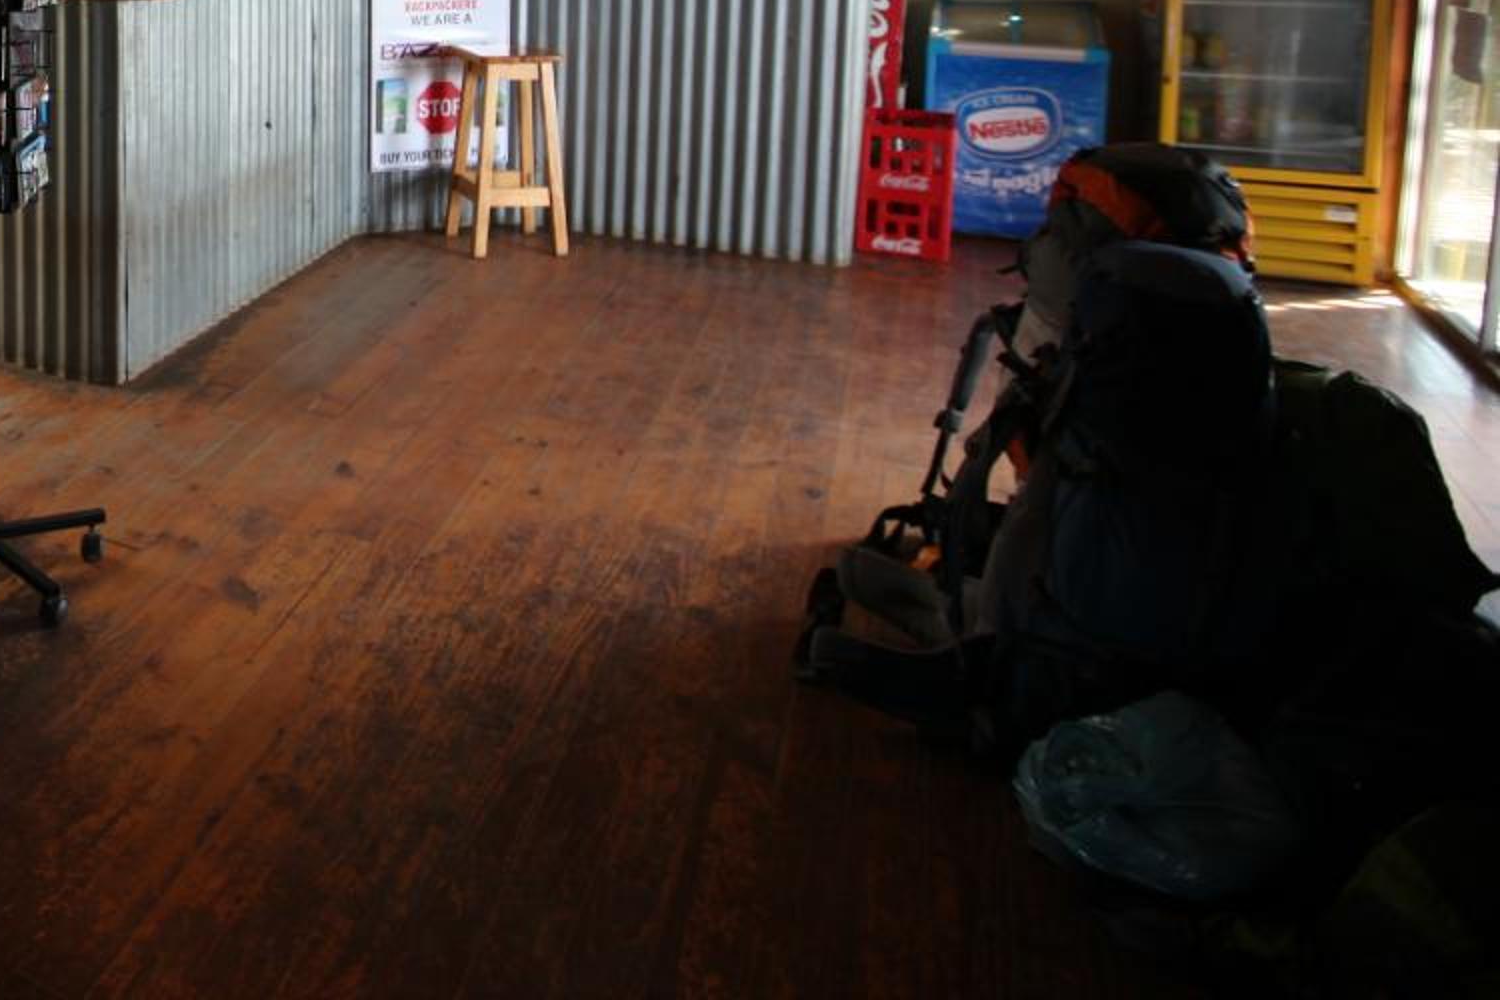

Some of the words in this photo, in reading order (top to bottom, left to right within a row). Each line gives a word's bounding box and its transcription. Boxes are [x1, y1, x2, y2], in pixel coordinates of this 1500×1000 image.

[411, 13, 430, 25] WE
[434, 12, 461, 24] ARE
[463, 12, 474, 24] A
[380, 151, 401, 165] BUY
[403, 150, 432, 163] YOUR
